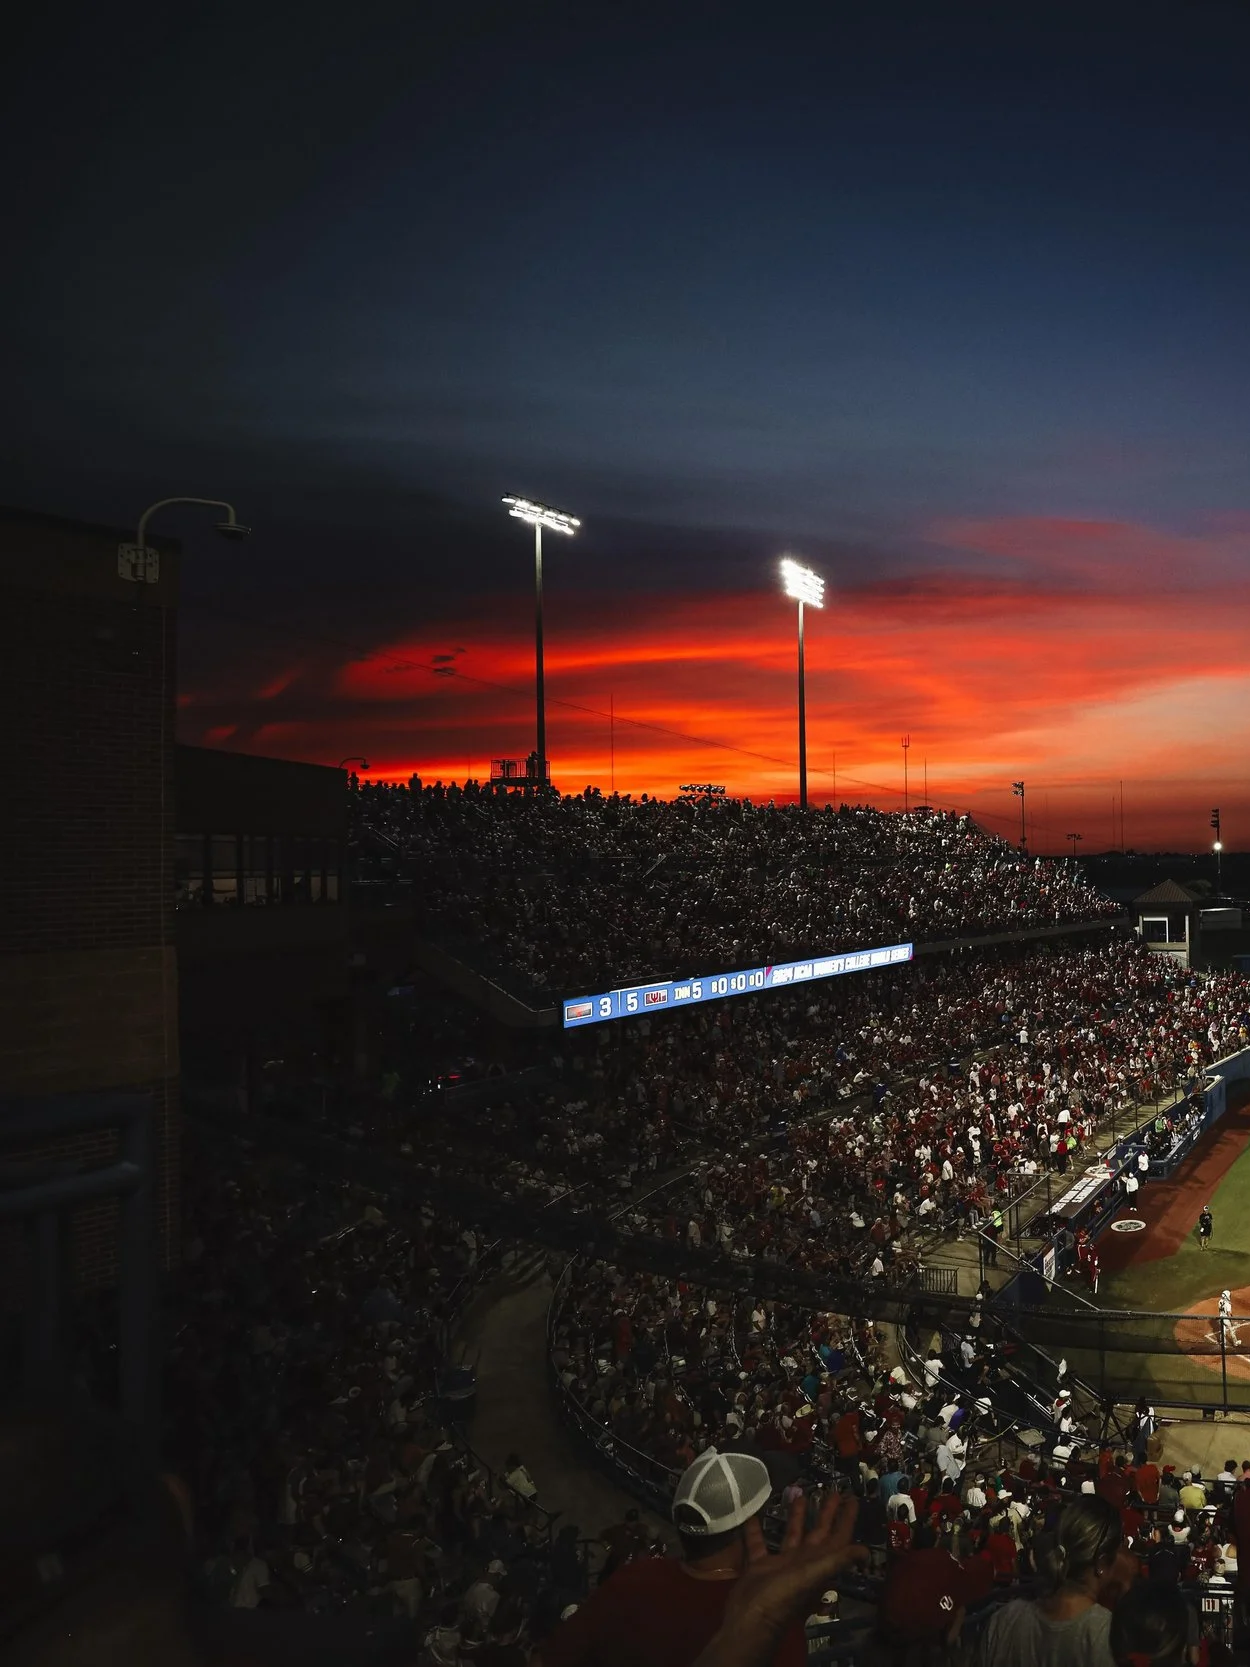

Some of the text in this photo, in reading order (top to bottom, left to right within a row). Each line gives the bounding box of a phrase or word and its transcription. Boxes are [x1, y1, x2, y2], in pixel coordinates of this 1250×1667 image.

[845, 954, 871, 970] COLLEGE
[718, 977, 727, 994] 0
[737, 974, 746, 991] 0
[755, 971, 764, 987] 0
[675, 986, 691, 1000] INN
[692, 982, 702, 999] 5
[600, 997, 612, 1017] 3
[626, 992, 638, 1012] 5
